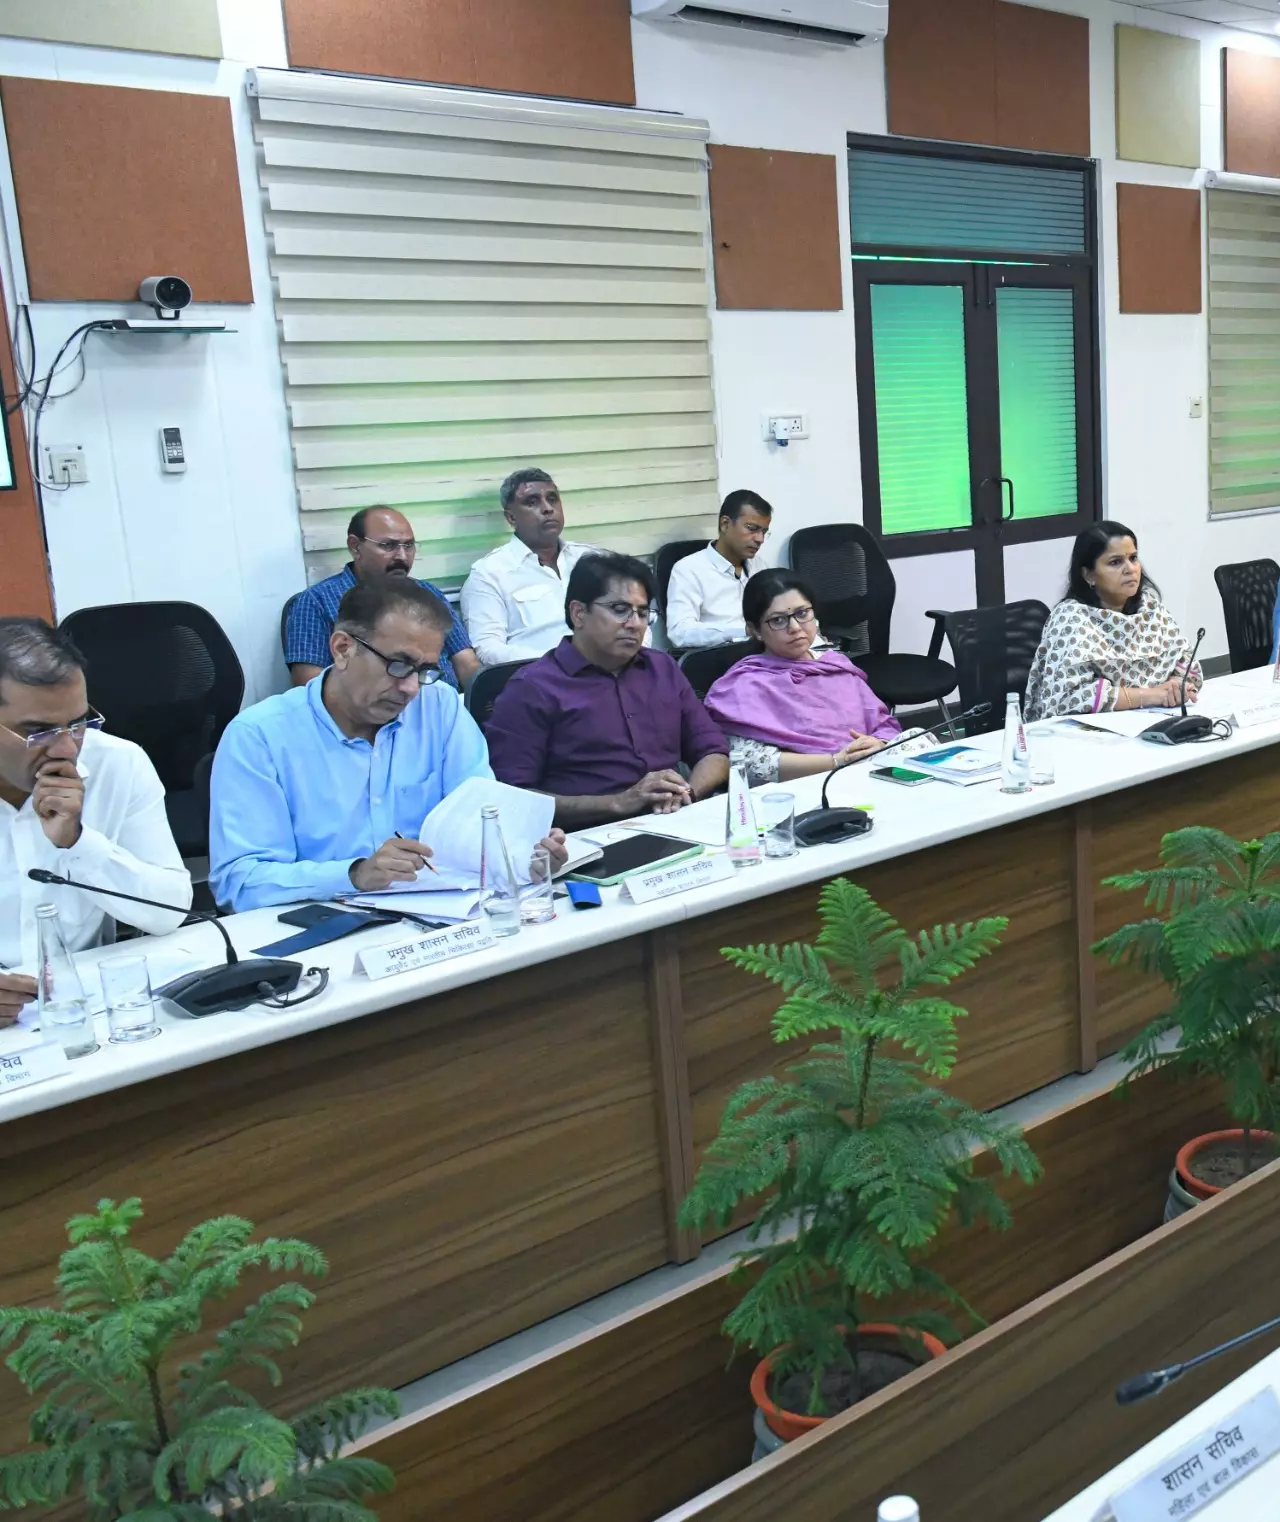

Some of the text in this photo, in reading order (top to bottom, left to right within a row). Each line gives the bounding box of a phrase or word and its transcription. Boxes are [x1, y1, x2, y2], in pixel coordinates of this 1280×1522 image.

[642, 874, 664, 888] प्रमुख
[666, 867, 689, 880] शासन
[691, 860, 713, 872] सचिव
[386, 925, 481, 960] प्रमुख शासन सचिव
[0, 1056, 22, 1069] चिव
[1161, 1425, 1245, 1491] शासन सचिव
